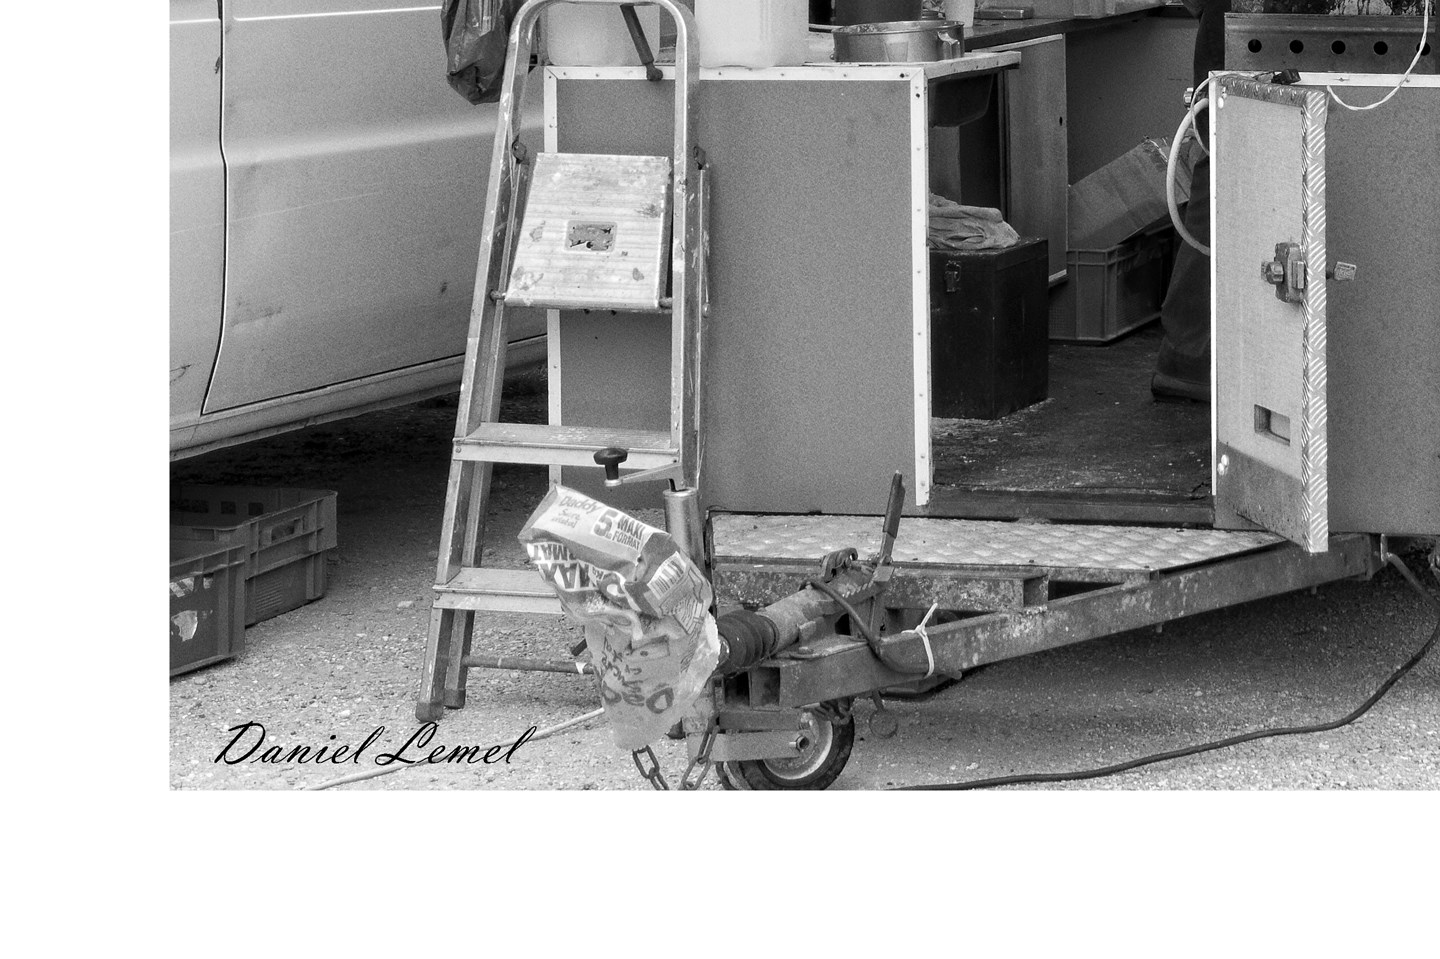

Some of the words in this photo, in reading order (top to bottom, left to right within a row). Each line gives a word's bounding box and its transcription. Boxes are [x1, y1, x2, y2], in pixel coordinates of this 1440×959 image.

[560, 495, 601, 514] Daddy
[594, 508, 619, 537] 5
[612, 529, 640, 551] FORMAT
